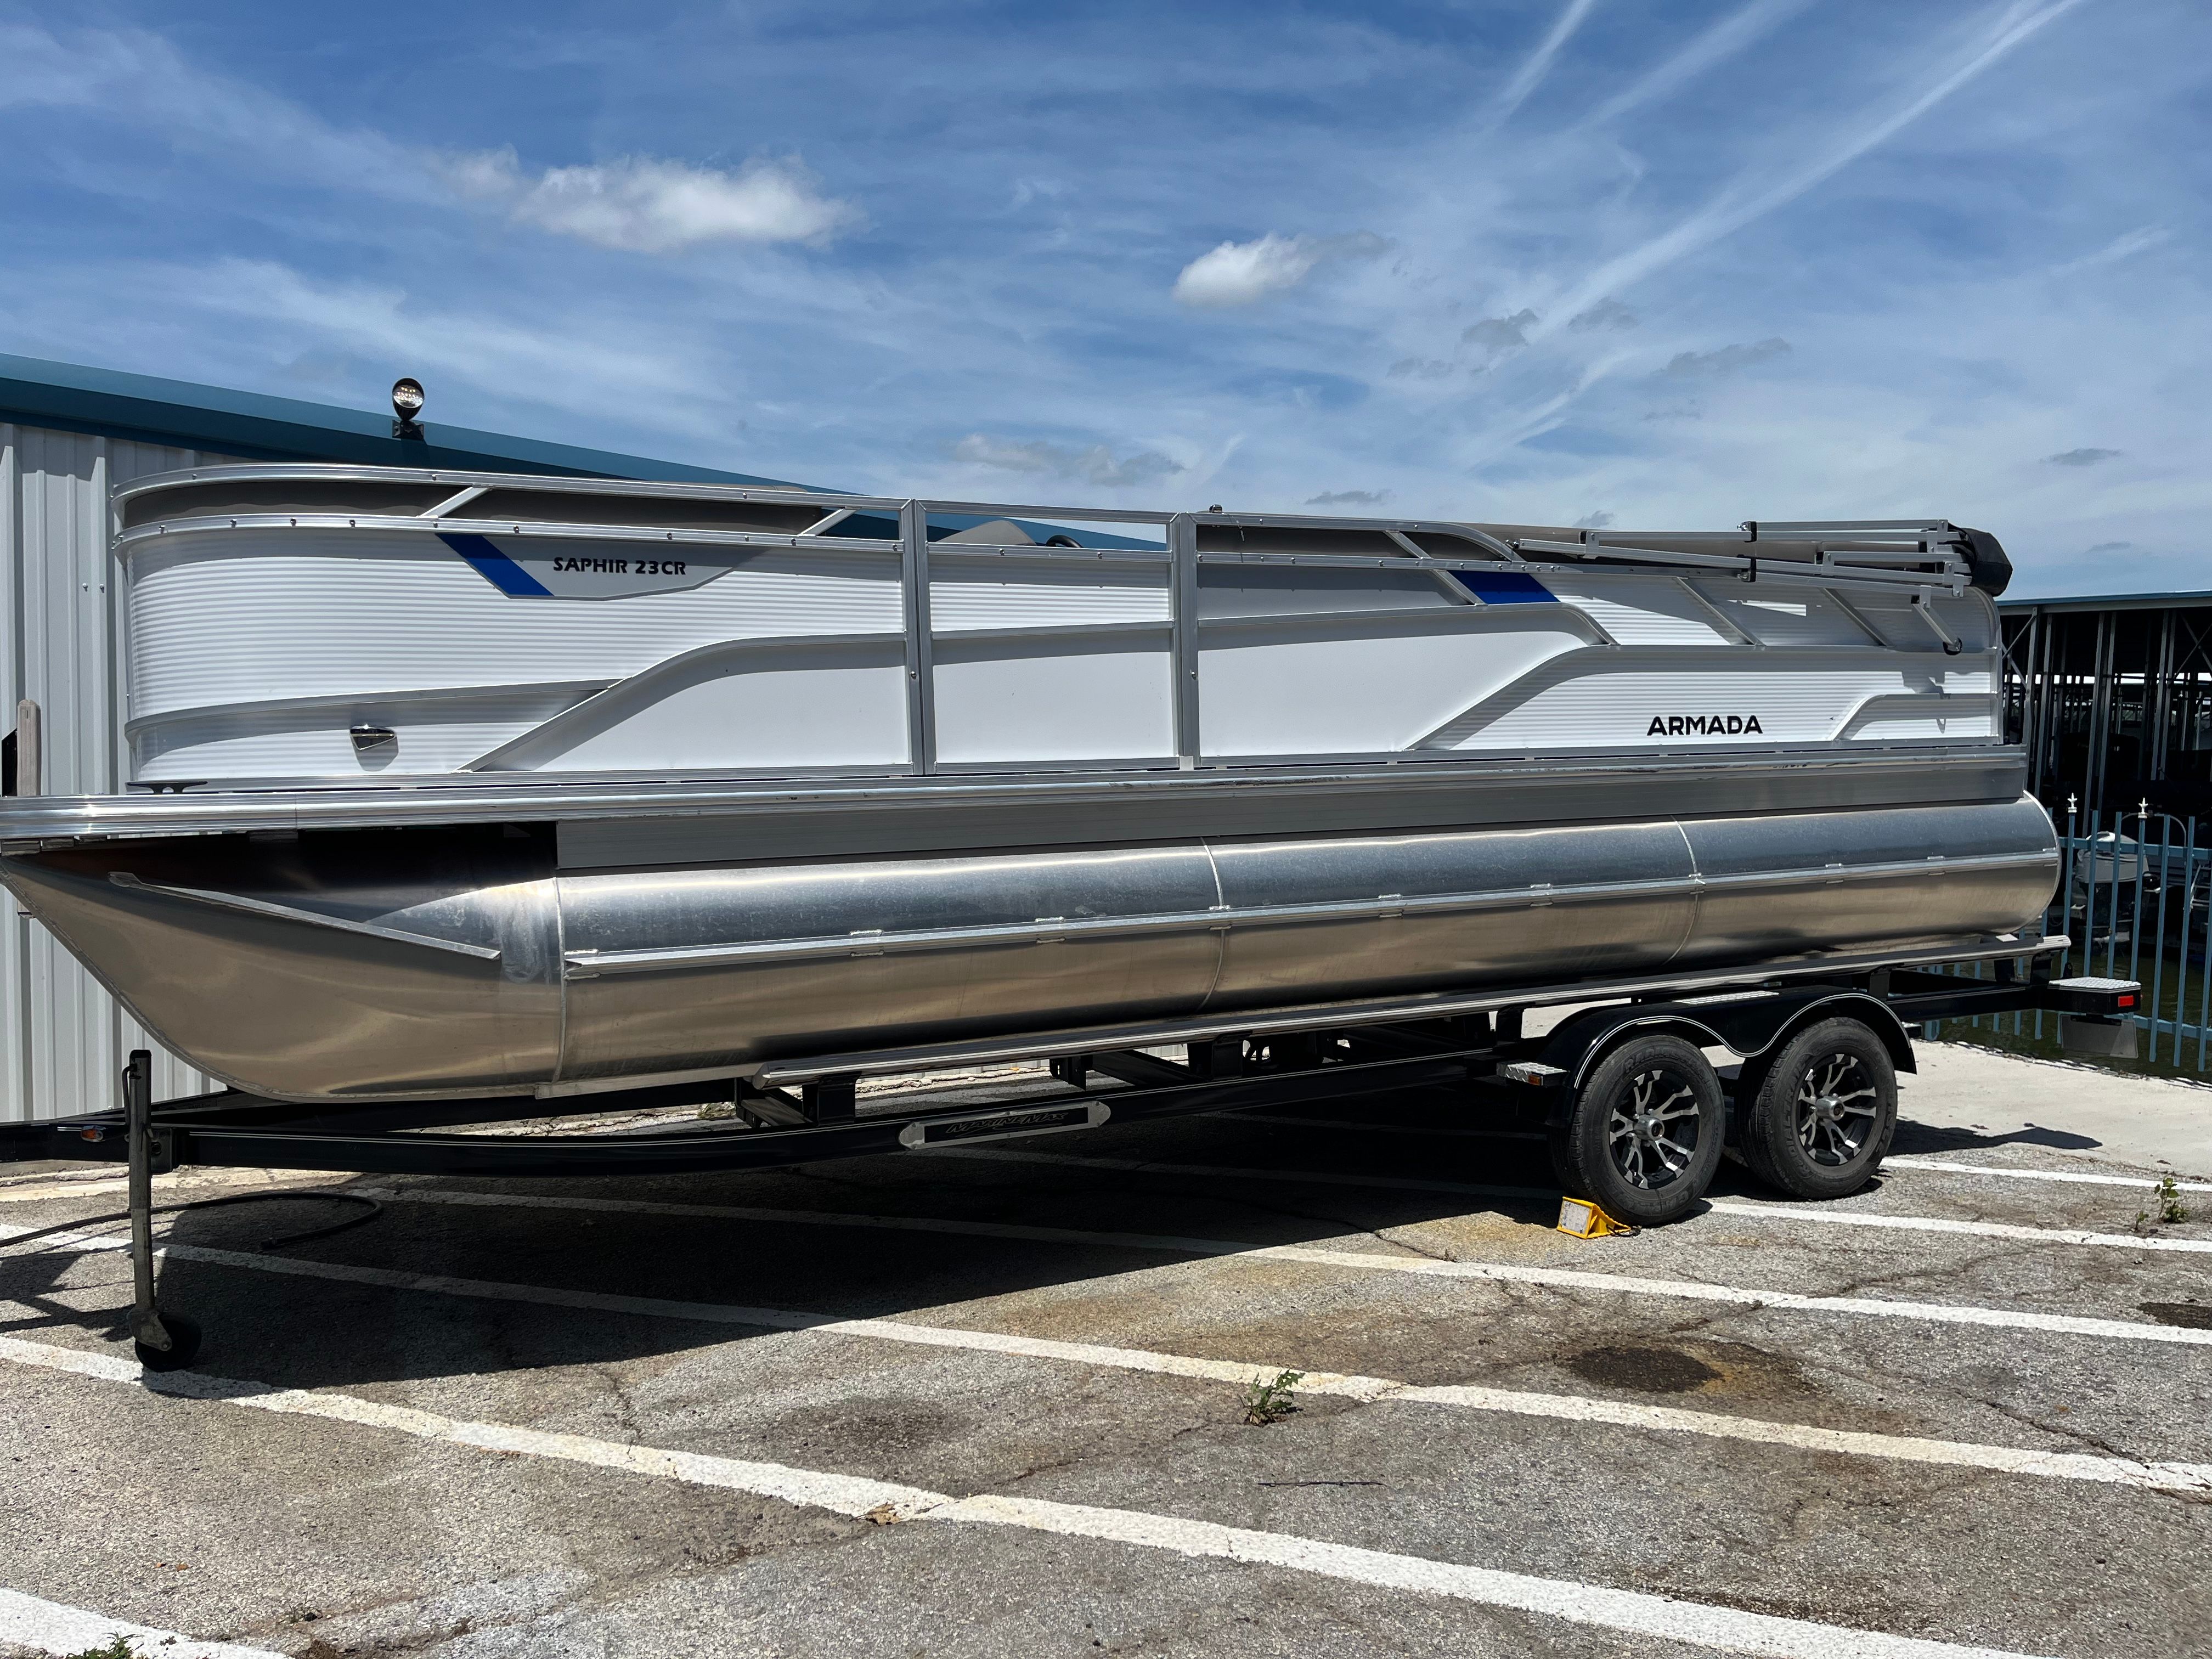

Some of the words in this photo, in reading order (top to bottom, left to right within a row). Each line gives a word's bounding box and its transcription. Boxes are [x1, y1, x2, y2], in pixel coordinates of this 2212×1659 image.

[553, 557, 627, 573] SAPHIR
[635, 560, 686, 575] 23CR
[1646, 715, 1763, 736] ARMADA
